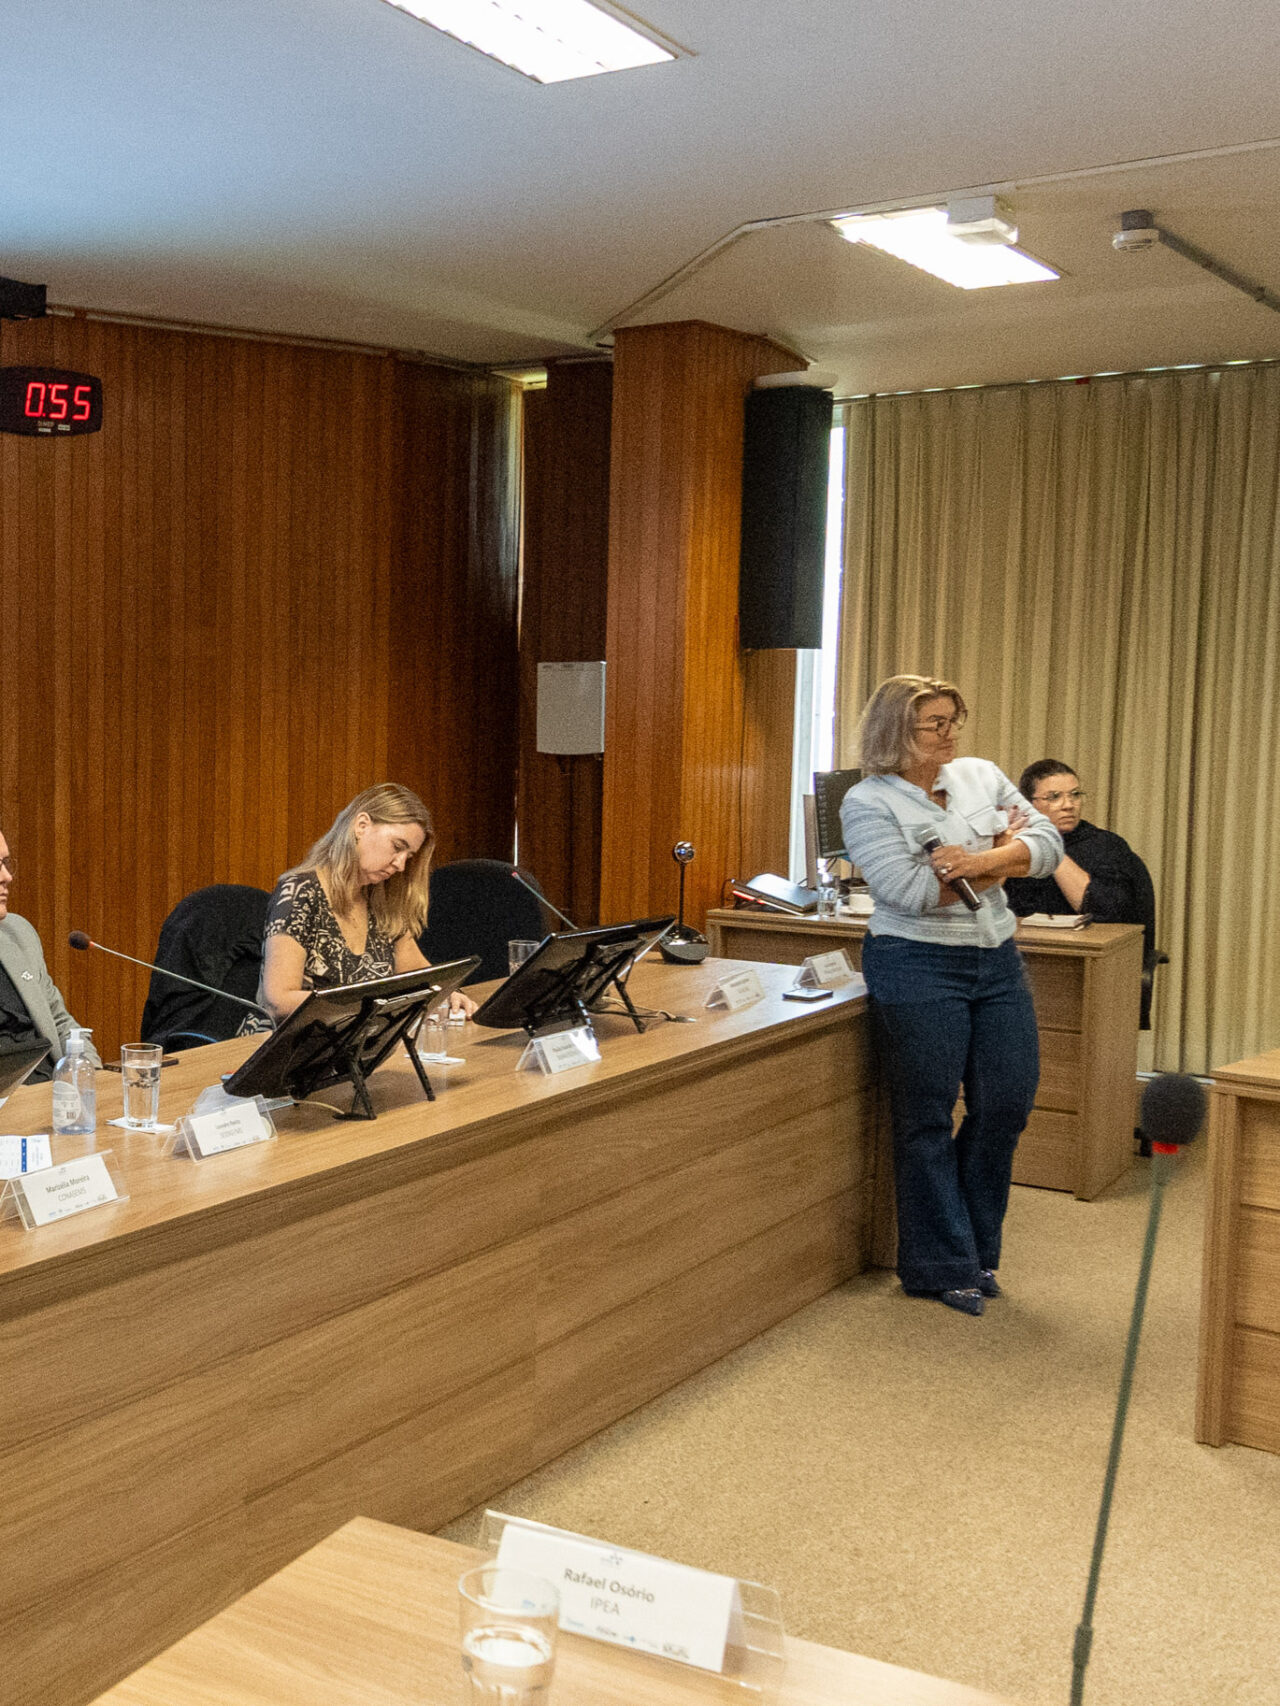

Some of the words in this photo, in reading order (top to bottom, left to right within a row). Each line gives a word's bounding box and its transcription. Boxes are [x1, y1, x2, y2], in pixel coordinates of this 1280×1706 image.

[564, 1568, 606, 1591] Rafael
[609, 1579, 656, 1603] Osório
[590, 1597, 620, 1617] IPEA
